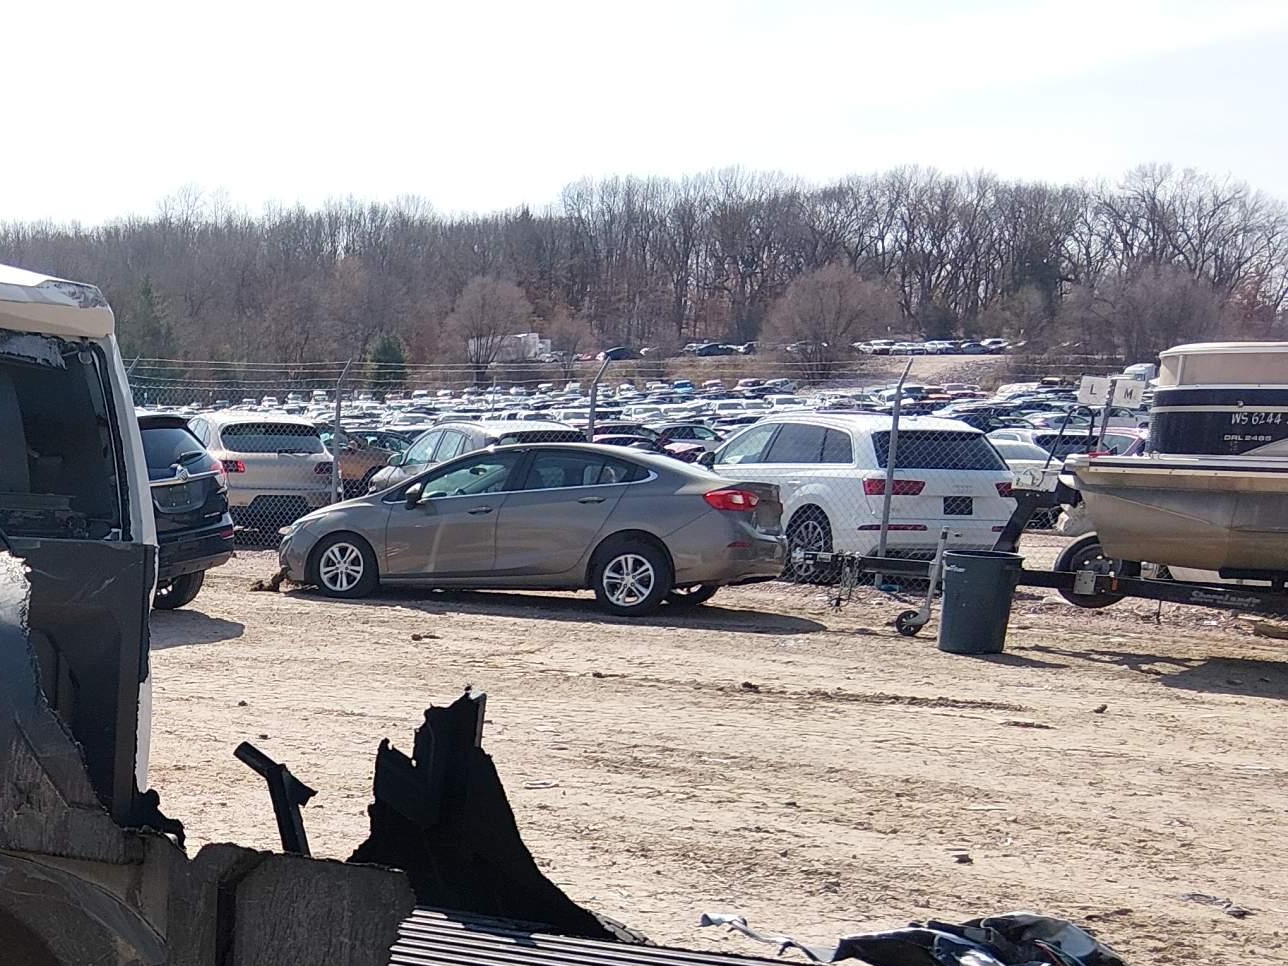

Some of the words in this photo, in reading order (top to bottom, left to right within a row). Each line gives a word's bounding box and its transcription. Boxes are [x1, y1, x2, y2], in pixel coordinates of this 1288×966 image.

[1089, 384, 1097, 395] L
[1123, 388, 1133, 400] M
[1231, 412, 1249, 425] WS
[1251, 412, 1282, 425] 6244
